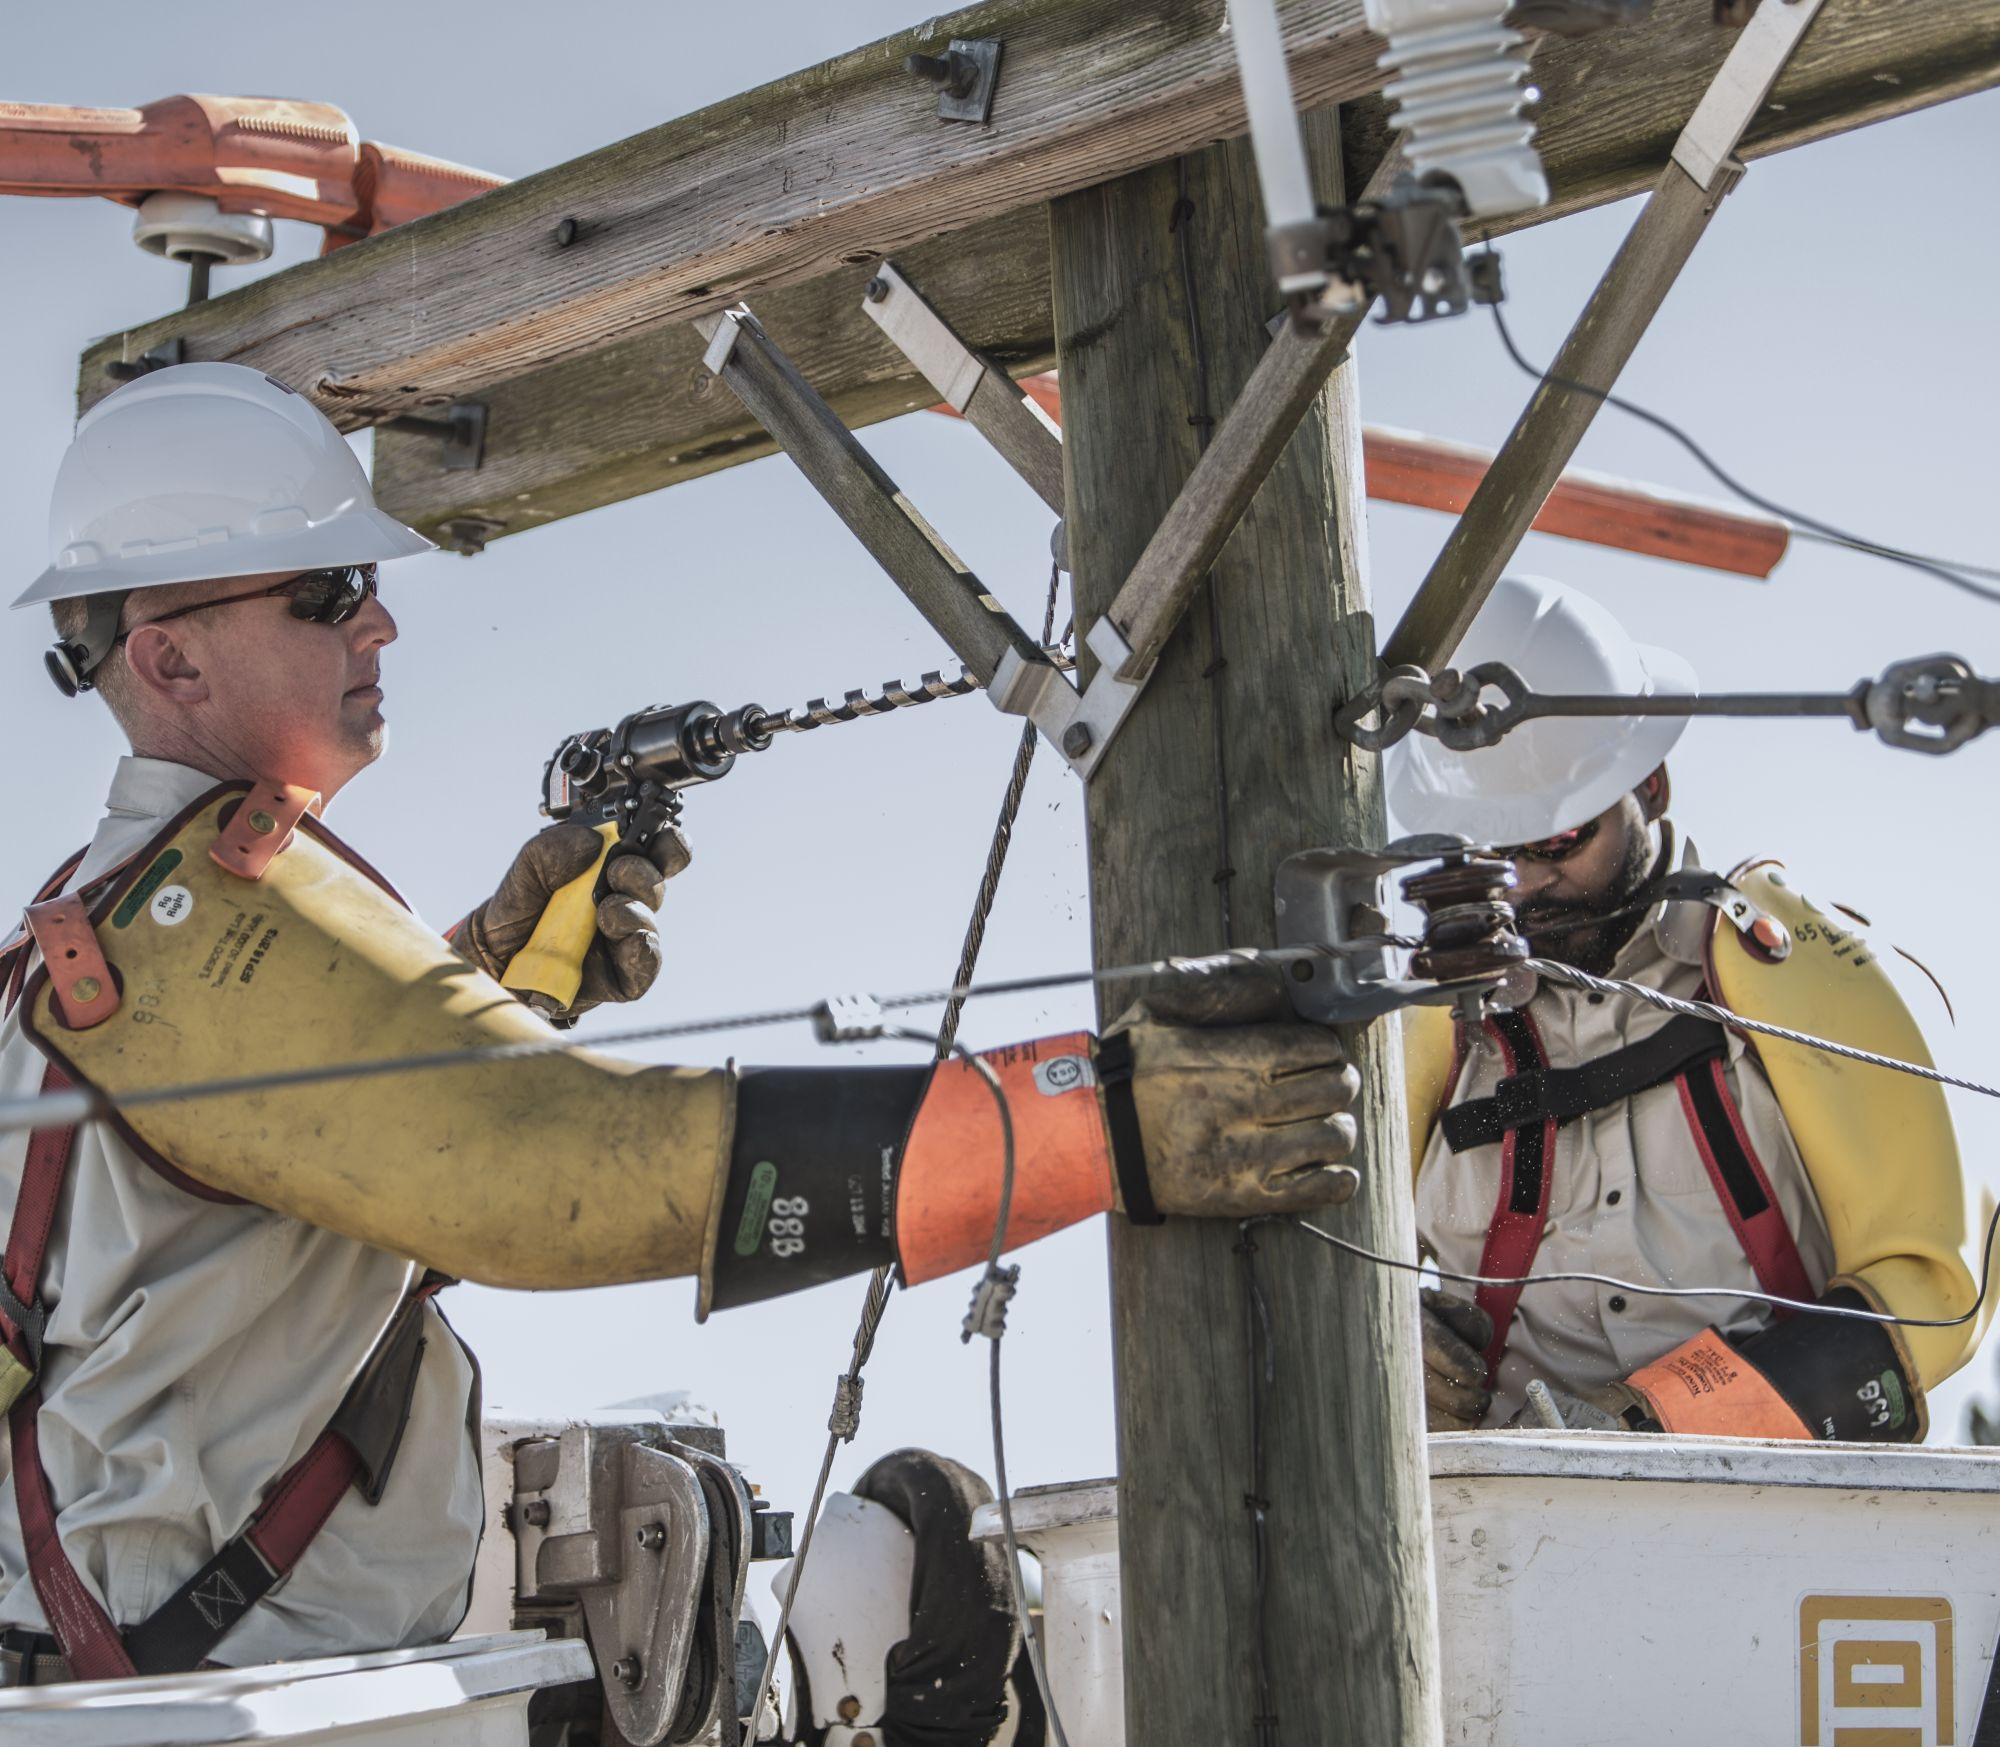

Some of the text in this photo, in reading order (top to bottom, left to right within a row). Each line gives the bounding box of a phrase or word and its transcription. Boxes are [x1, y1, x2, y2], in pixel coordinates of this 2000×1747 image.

[158, 896, 172, 908] Rg
[167, 893, 185, 917] Right
[238, 962, 256, 984] SEP
